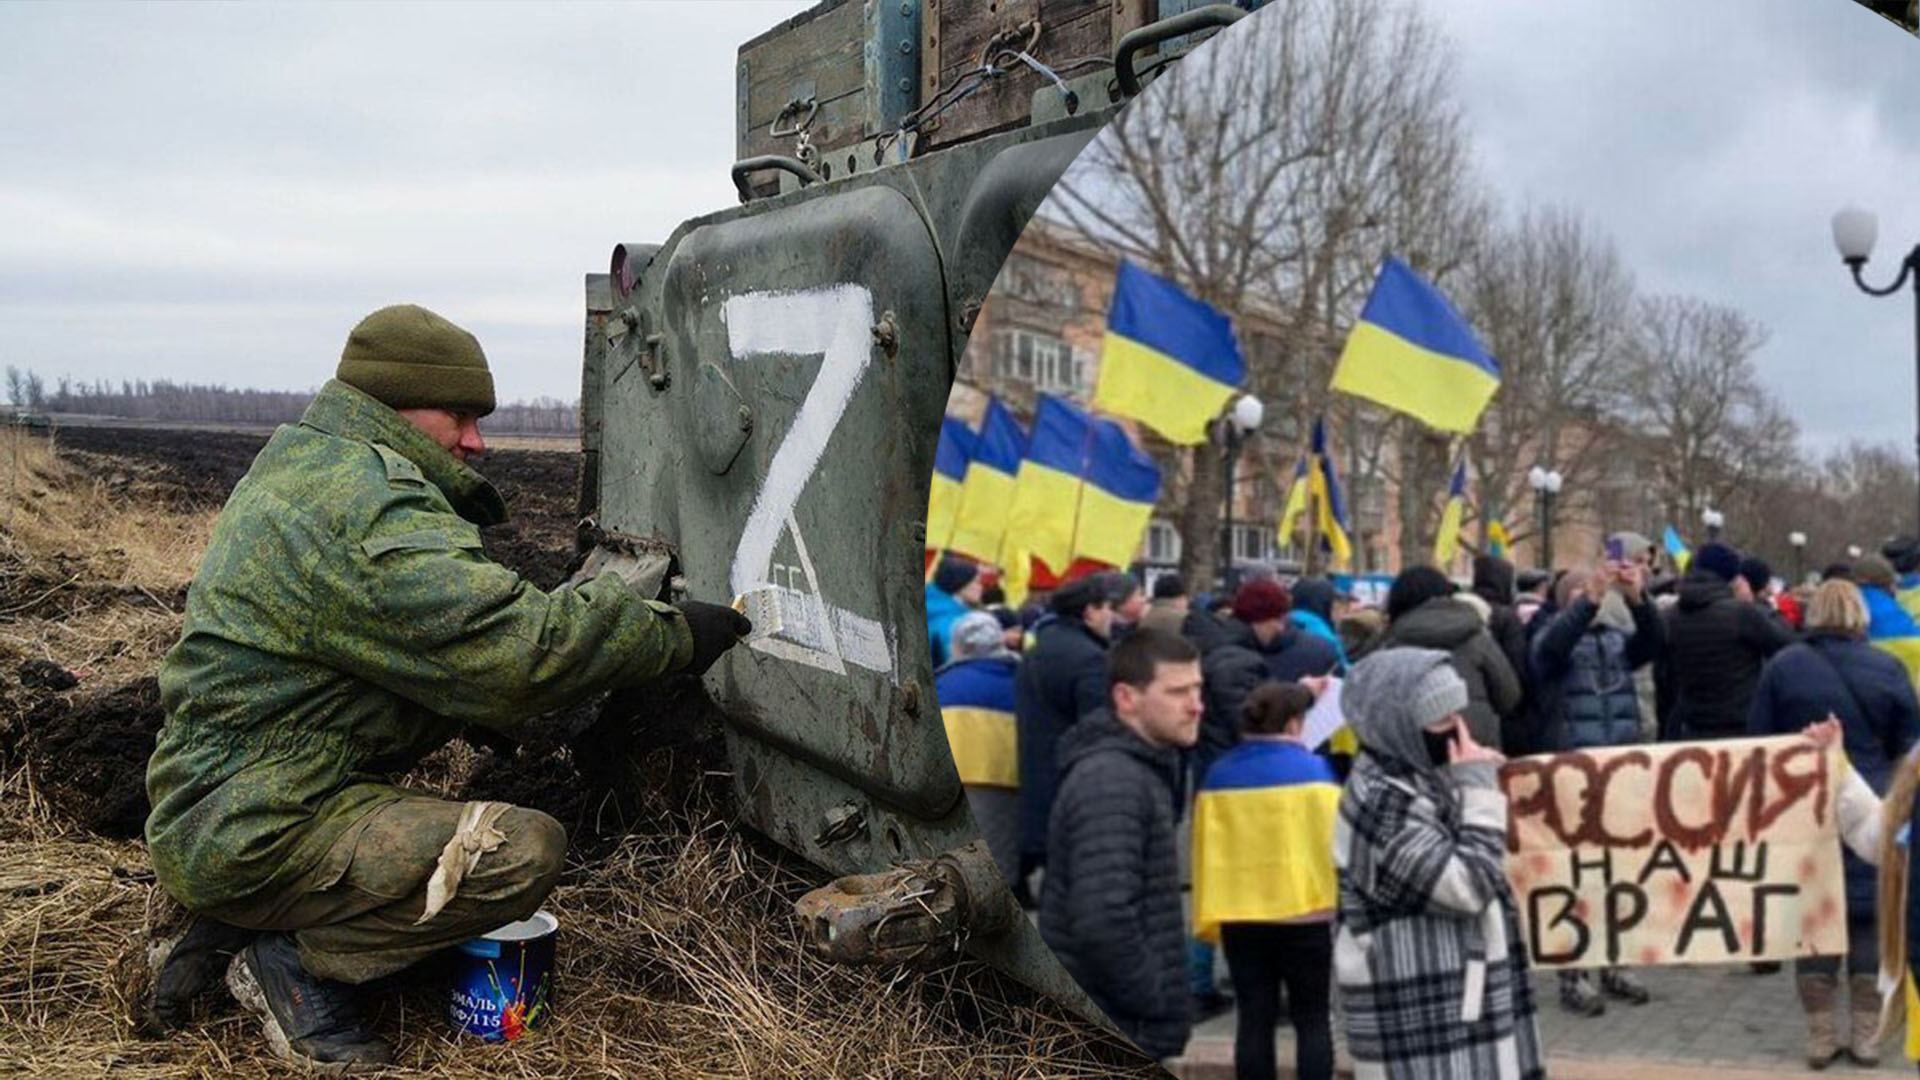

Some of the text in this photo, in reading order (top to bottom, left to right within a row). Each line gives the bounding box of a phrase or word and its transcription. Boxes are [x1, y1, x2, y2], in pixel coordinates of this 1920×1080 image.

[725, 282, 893, 674] Z
[1498, 743, 1828, 854] РОССИЯ
[1570, 840, 1768, 890] НАШ
[1528, 880, 1800, 964] ВРАГ
